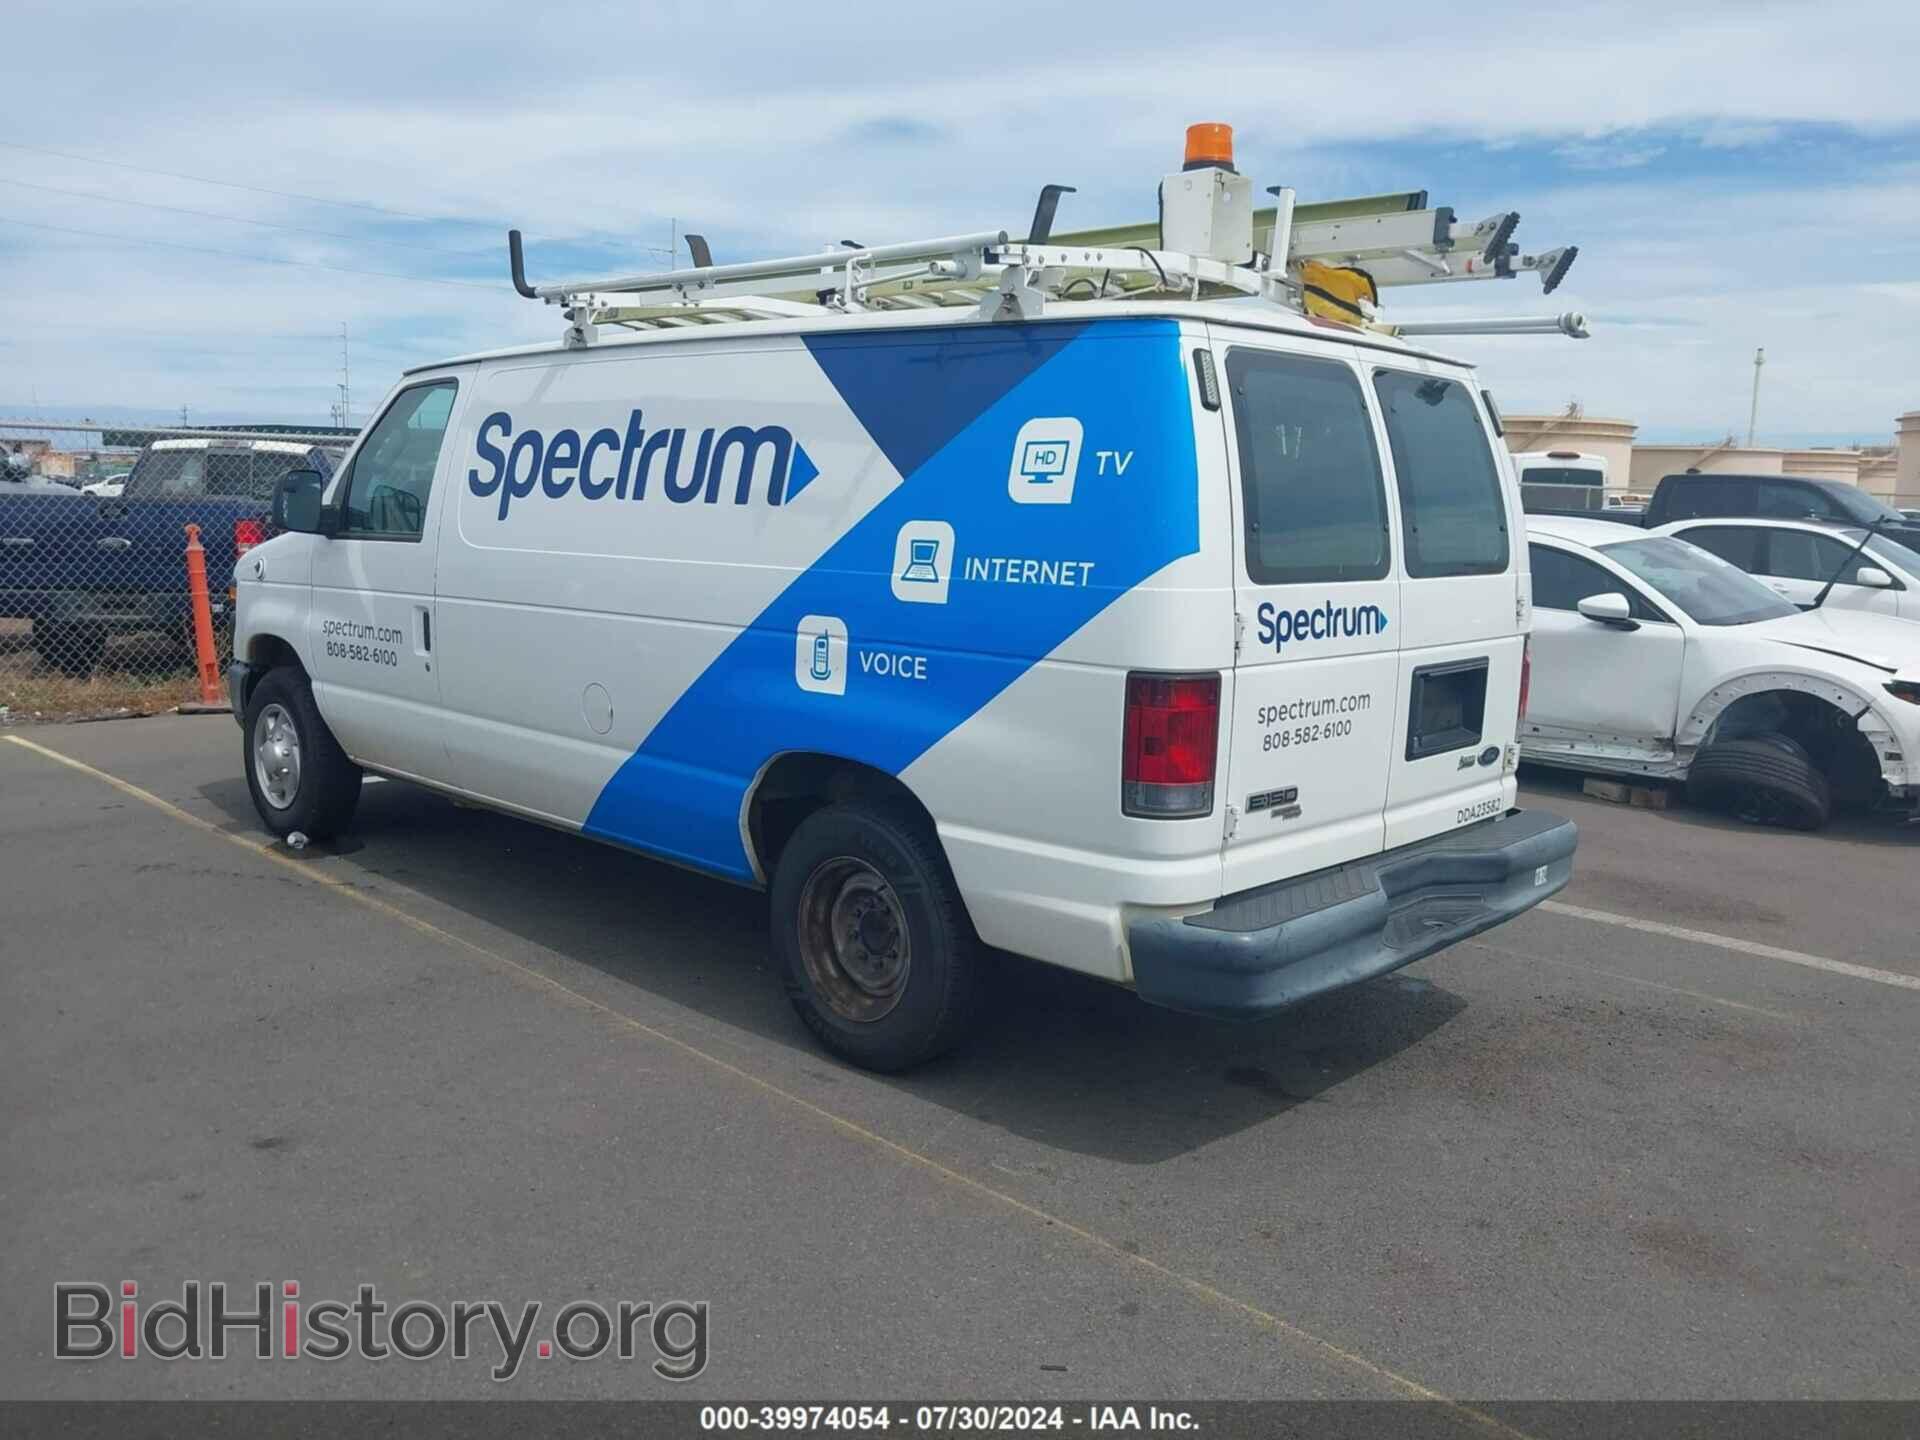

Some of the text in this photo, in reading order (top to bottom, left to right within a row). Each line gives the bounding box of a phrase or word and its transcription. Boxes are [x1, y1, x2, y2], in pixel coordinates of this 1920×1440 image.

[468, 409, 796, 521] Spectrum
[1034, 450, 1057, 466] HD
[1096, 451, 1134, 476] TV
[964, 558, 1095, 587] INTERNET
[322, 619, 403, 644] spectrum.com
[1257, 600, 1380, 653] Spectrum
[326, 641, 398, 667] 808-582-6100
[859, 650, 927, 681] VOICE
[1257, 692, 1371, 726] spectrum.com
[1262, 719, 1353, 752] 808-582-6100
